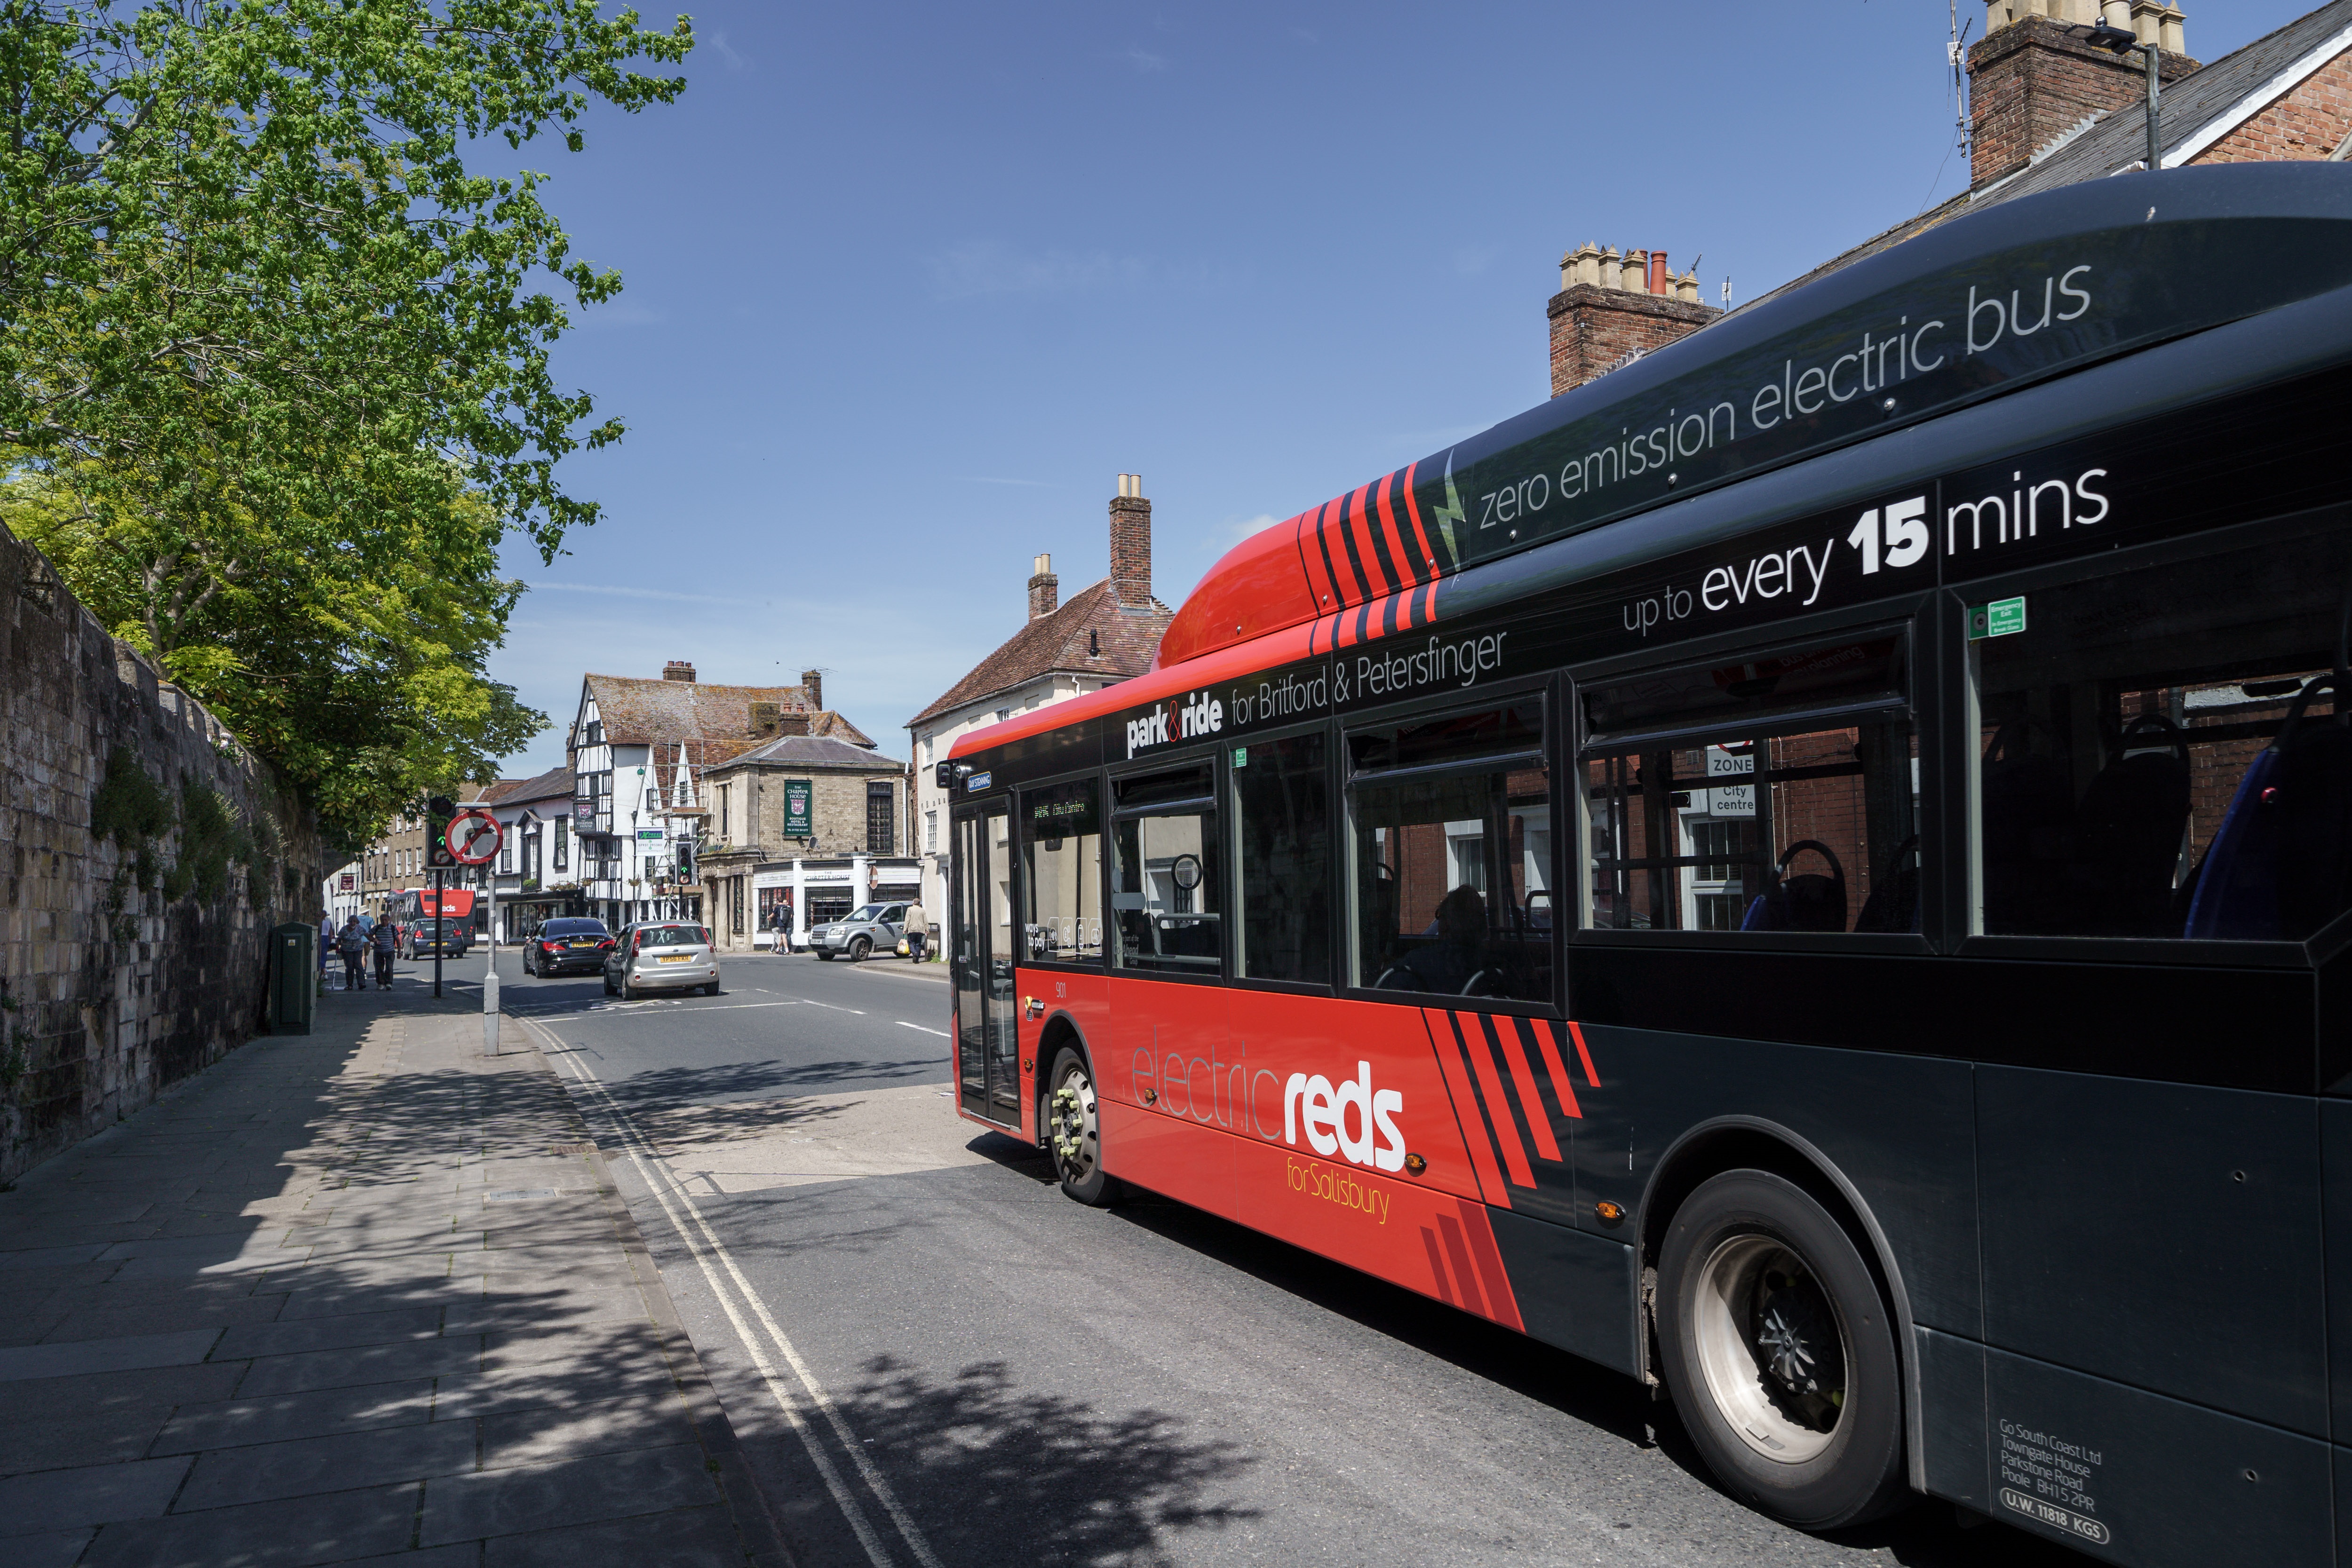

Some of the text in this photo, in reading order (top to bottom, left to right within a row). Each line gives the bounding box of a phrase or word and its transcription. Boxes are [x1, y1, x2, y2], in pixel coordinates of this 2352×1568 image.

[1480, 265, 2091, 530] zero emission electric bus
[1623, 468, 2110, 637] up to every 15 mins
[1991, 602, 2021, 612] Emergency
[1232, 689, 1255, 726] for
[1260, 667, 1327, 720] Britford
[1335, 662, 1350, 703] &
[1358, 632, 1507, 697] Petersfinger
[975, 775, 990, 787] STENNING
[1714, 759, 1753, 771] ZONE
[1717, 800, 1754, 809] centre
[1724, 786, 1746, 798] City
[1025, 923, 1039, 936] ways
[1028, 934, 1045, 951] to pay
[1056, 982, 1066, 998] 901
[1132, 1025, 1406, 1172] electric reds
[1287, 1157, 1390, 1225] for Salisbury
[2000, 1419, 2101, 1465] Go South Coast Ltd
[2000, 1433, 2091, 1478] Towngate House
[2001, 1449, 2083, 1491] Parkstone Road
[2002, 1465, 2095, 1512] Poole BH15 2PR
[2006, 1492, 2100, 1538] U.W. 11818 KGS
